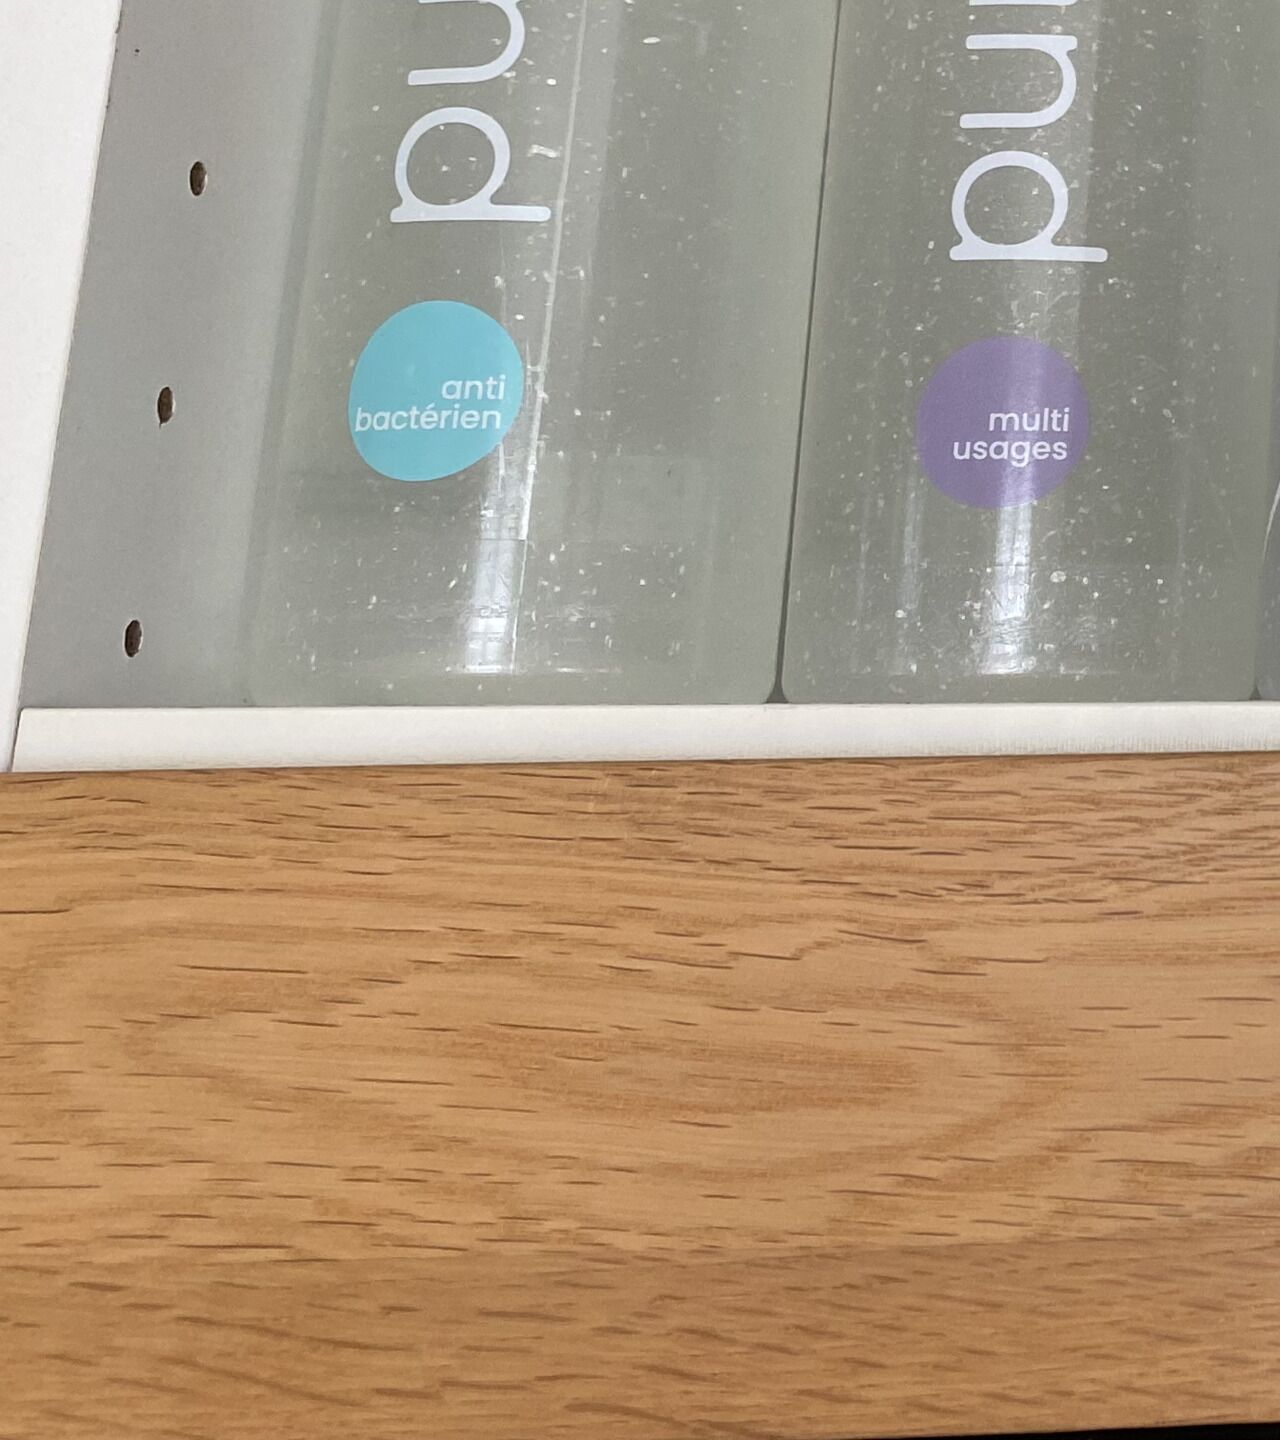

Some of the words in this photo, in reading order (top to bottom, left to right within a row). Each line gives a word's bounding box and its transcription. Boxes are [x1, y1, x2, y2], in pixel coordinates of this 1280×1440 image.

[442, 374, 506, 401] anti
[355, 403, 502, 433] bactérien
[988, 406, 1071, 433] multi
[952, 436, 1068, 466] usages
